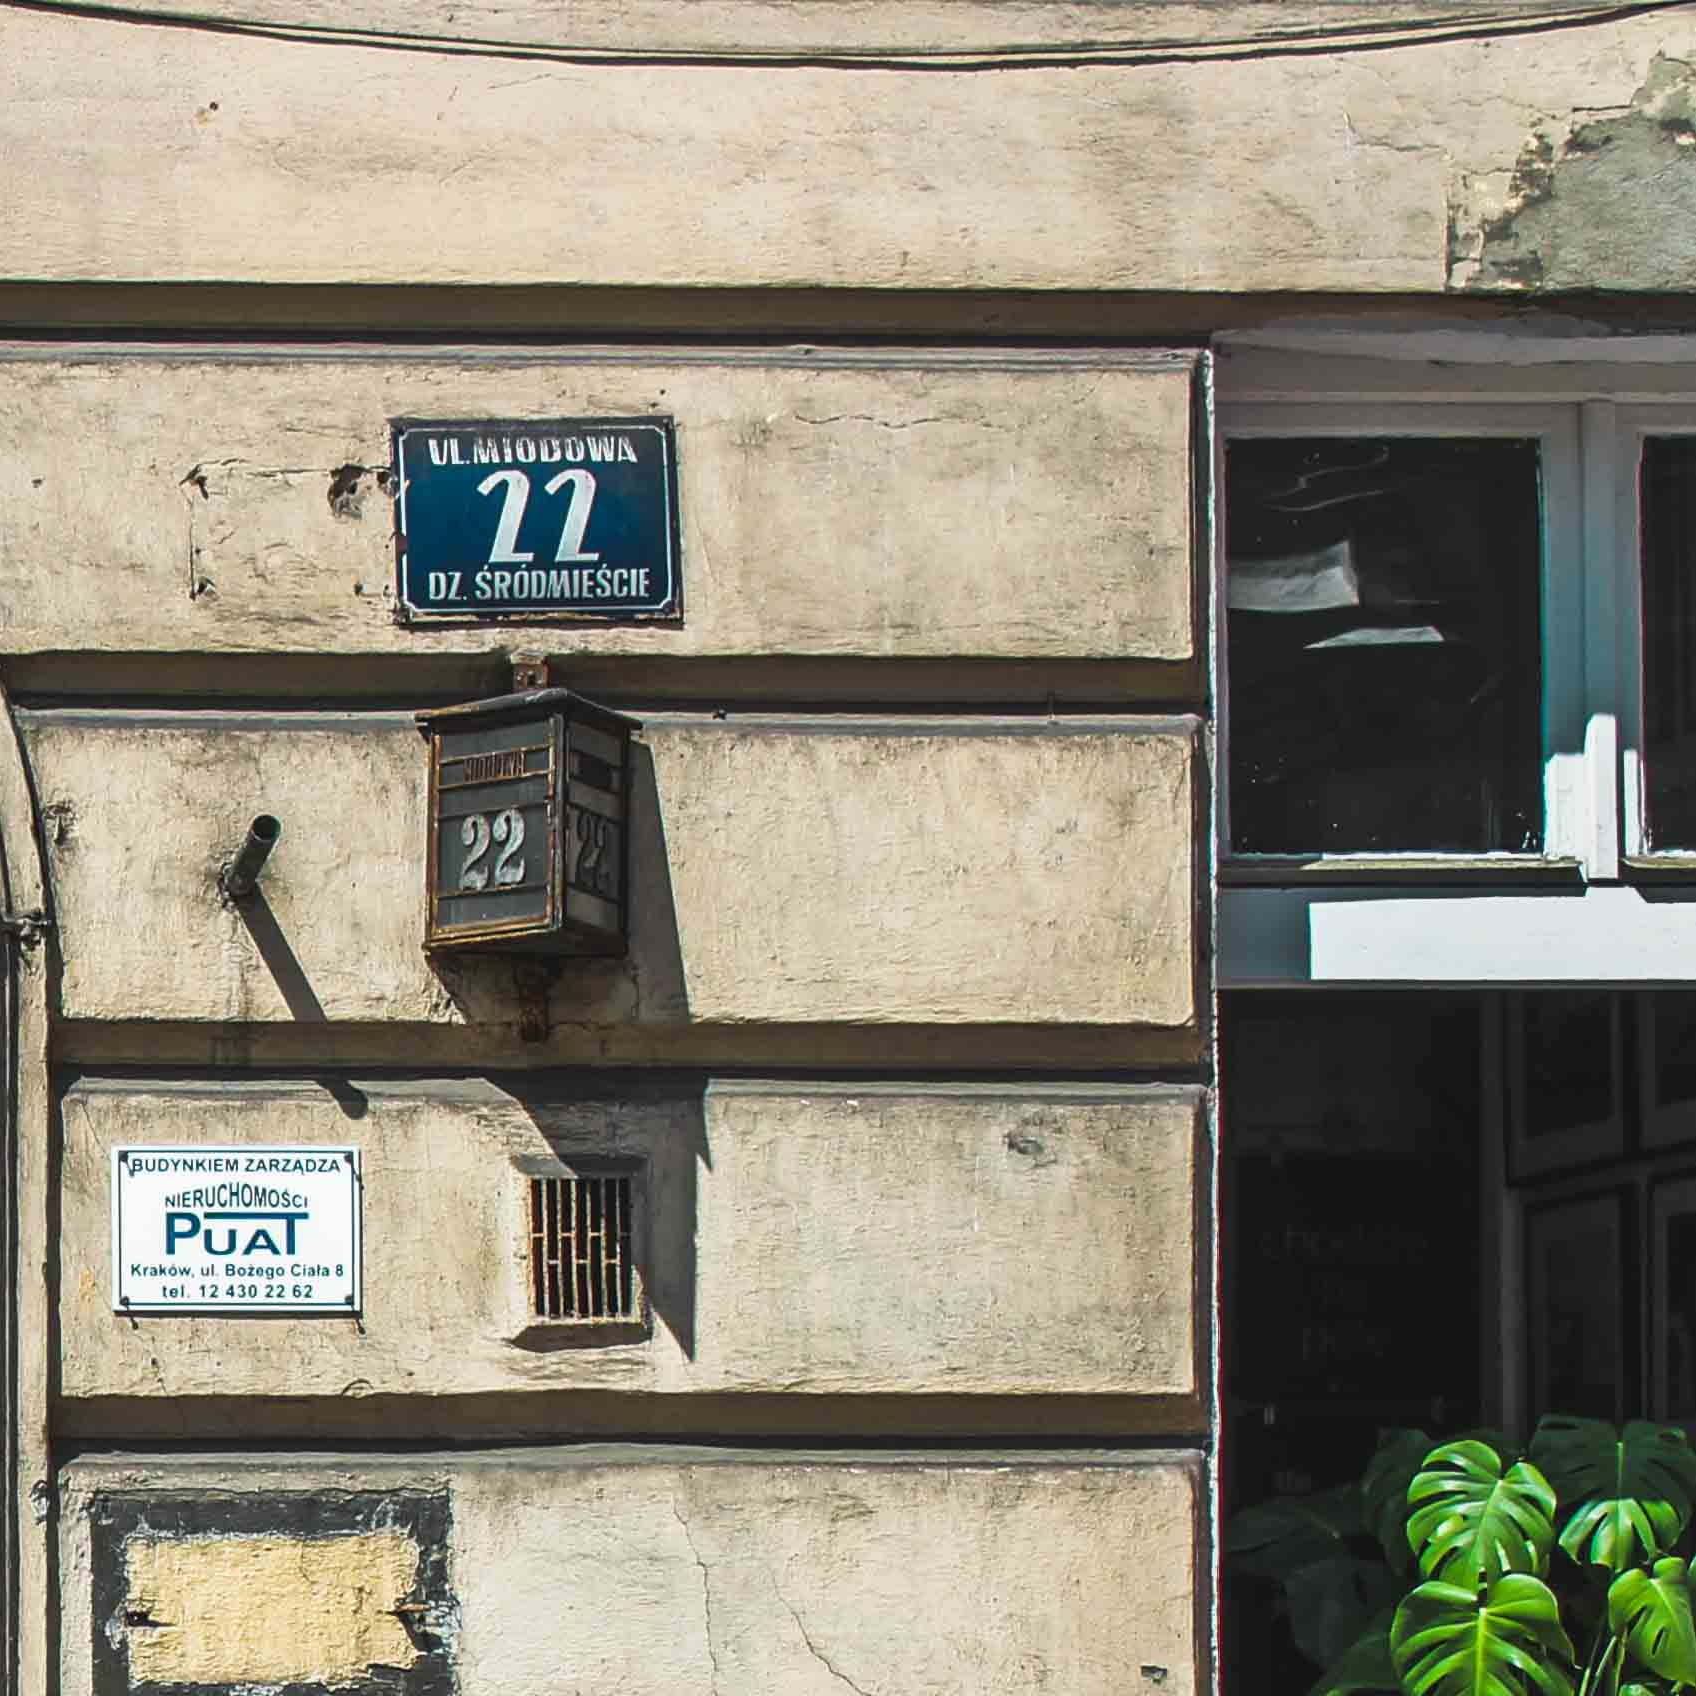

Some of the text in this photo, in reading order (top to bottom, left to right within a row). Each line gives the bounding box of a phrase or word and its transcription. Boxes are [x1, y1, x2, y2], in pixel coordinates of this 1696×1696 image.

[476, 468, 600, 563] 22
[428, 563, 651, 600] DZ. ŚRÓDMIEŚCIE
[459, 806, 526, 891] 22
[132, 1158, 341, 1176] BUDYNKIEM ZARZĄDZA
[164, 1182, 309, 1209] NIERUCHOMOŚCI
[130, 1262, 344, 1281] Kraków, ul. Bożego Ciała 8
[161, 1284, 314, 1299] tel. 12 430 22 62
